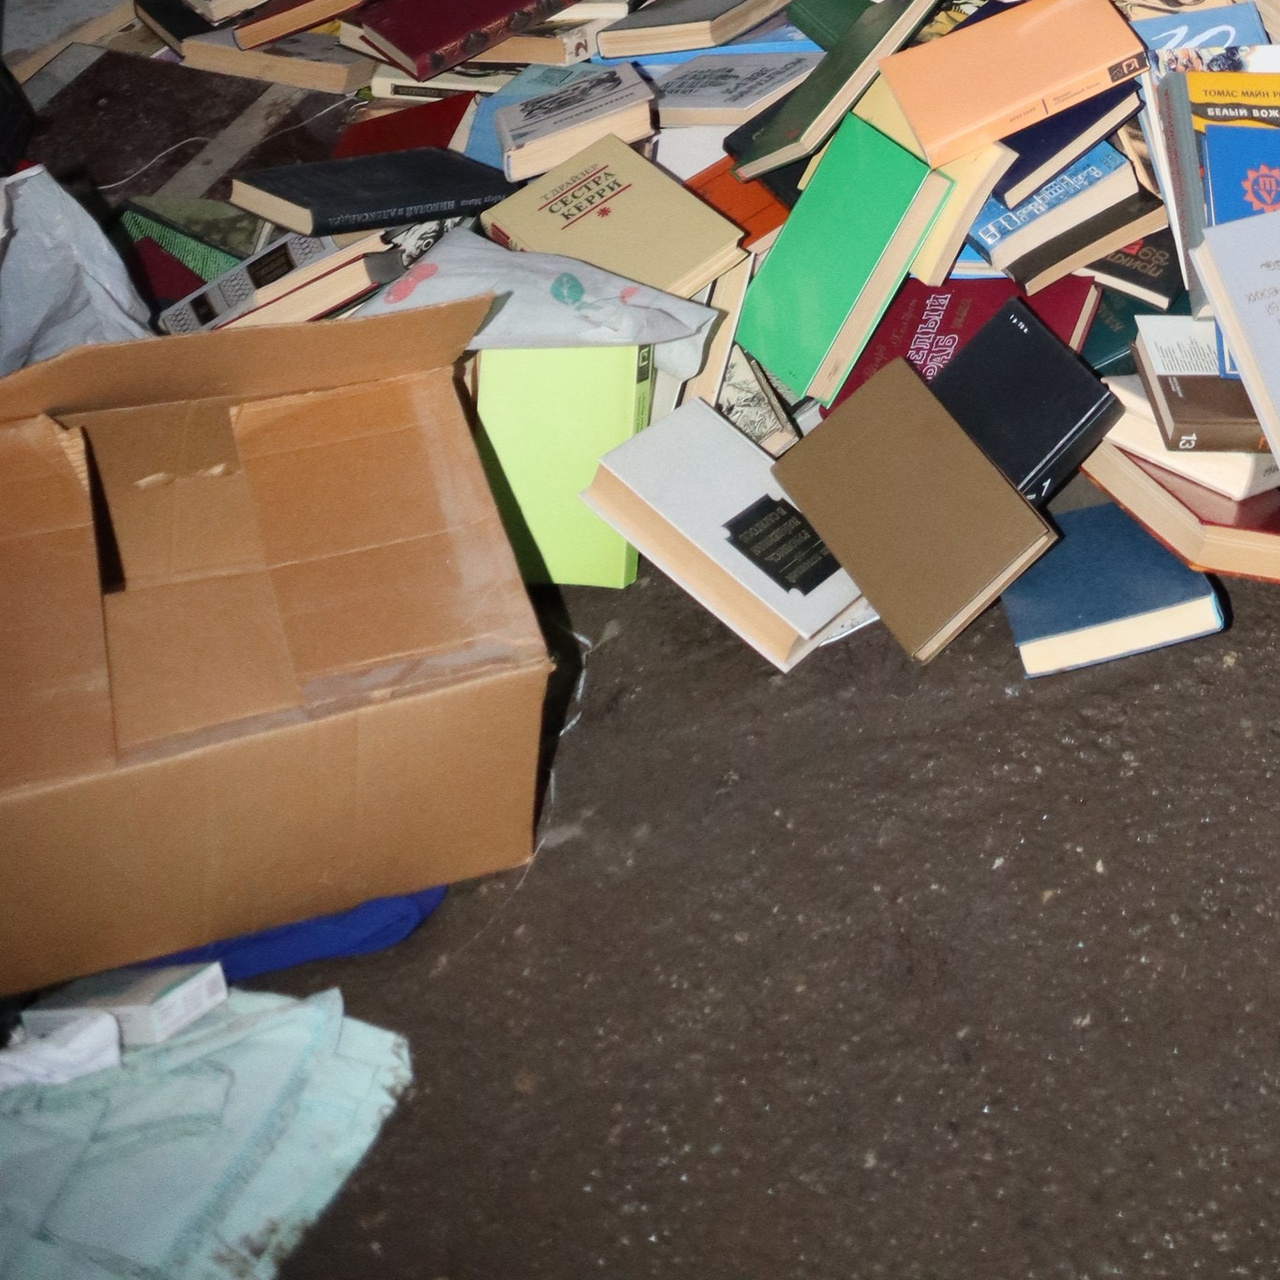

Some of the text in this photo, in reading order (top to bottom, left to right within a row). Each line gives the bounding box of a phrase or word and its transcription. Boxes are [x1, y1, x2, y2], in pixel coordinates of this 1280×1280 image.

[1202, 87, 1237, 99] ТОМАС
[1240, 89, 1269, 99] МАЙН
[1206, 104, 1248, 119] БЕЛЫЙ
[547, 169, 616, 215] СЕСТРА
[560, 178, 624, 223] КЕРРИ
[406, 200, 456, 224] НИКОЛАЙ
[907, 293, 951, 372] ЕЛЫЙ
[1176, 431, 1198, 452] 13
